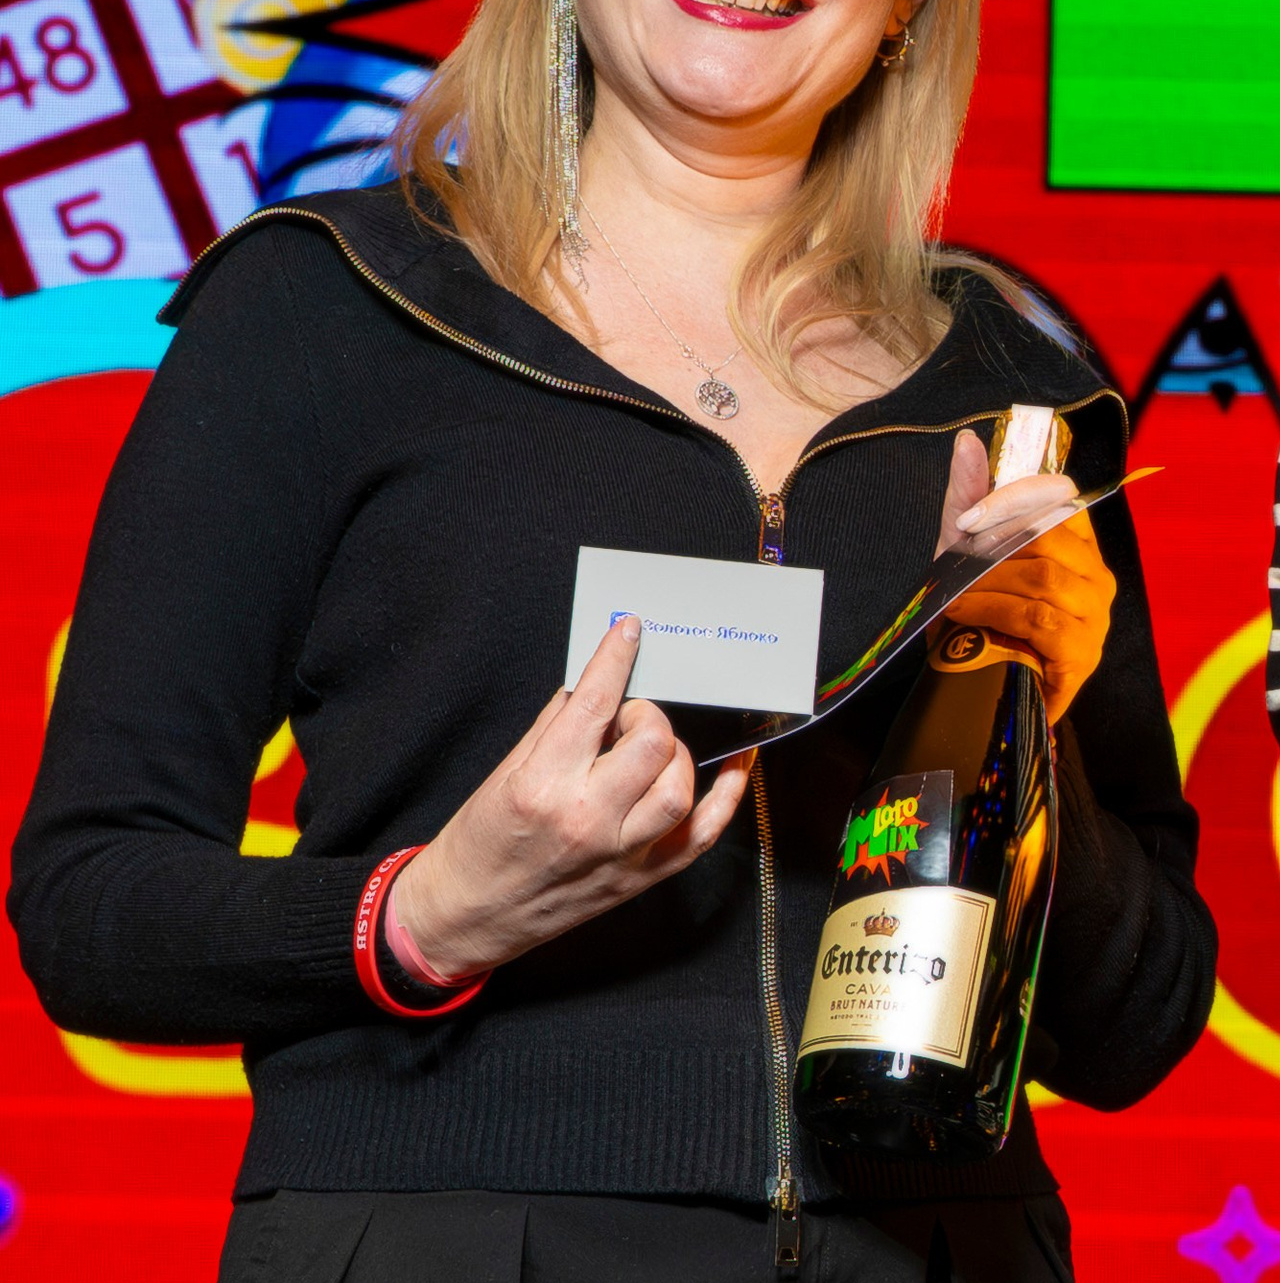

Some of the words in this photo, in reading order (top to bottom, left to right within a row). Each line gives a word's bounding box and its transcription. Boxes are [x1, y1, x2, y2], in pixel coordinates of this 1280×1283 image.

[54, 191, 127, 275] 5
[716, 625, 779, 644] Яблоко
[356, 875, 383, 951] ASTRO
[844, 983, 892, 996] CAVA
[830, 998, 857, 1012] BRUT
